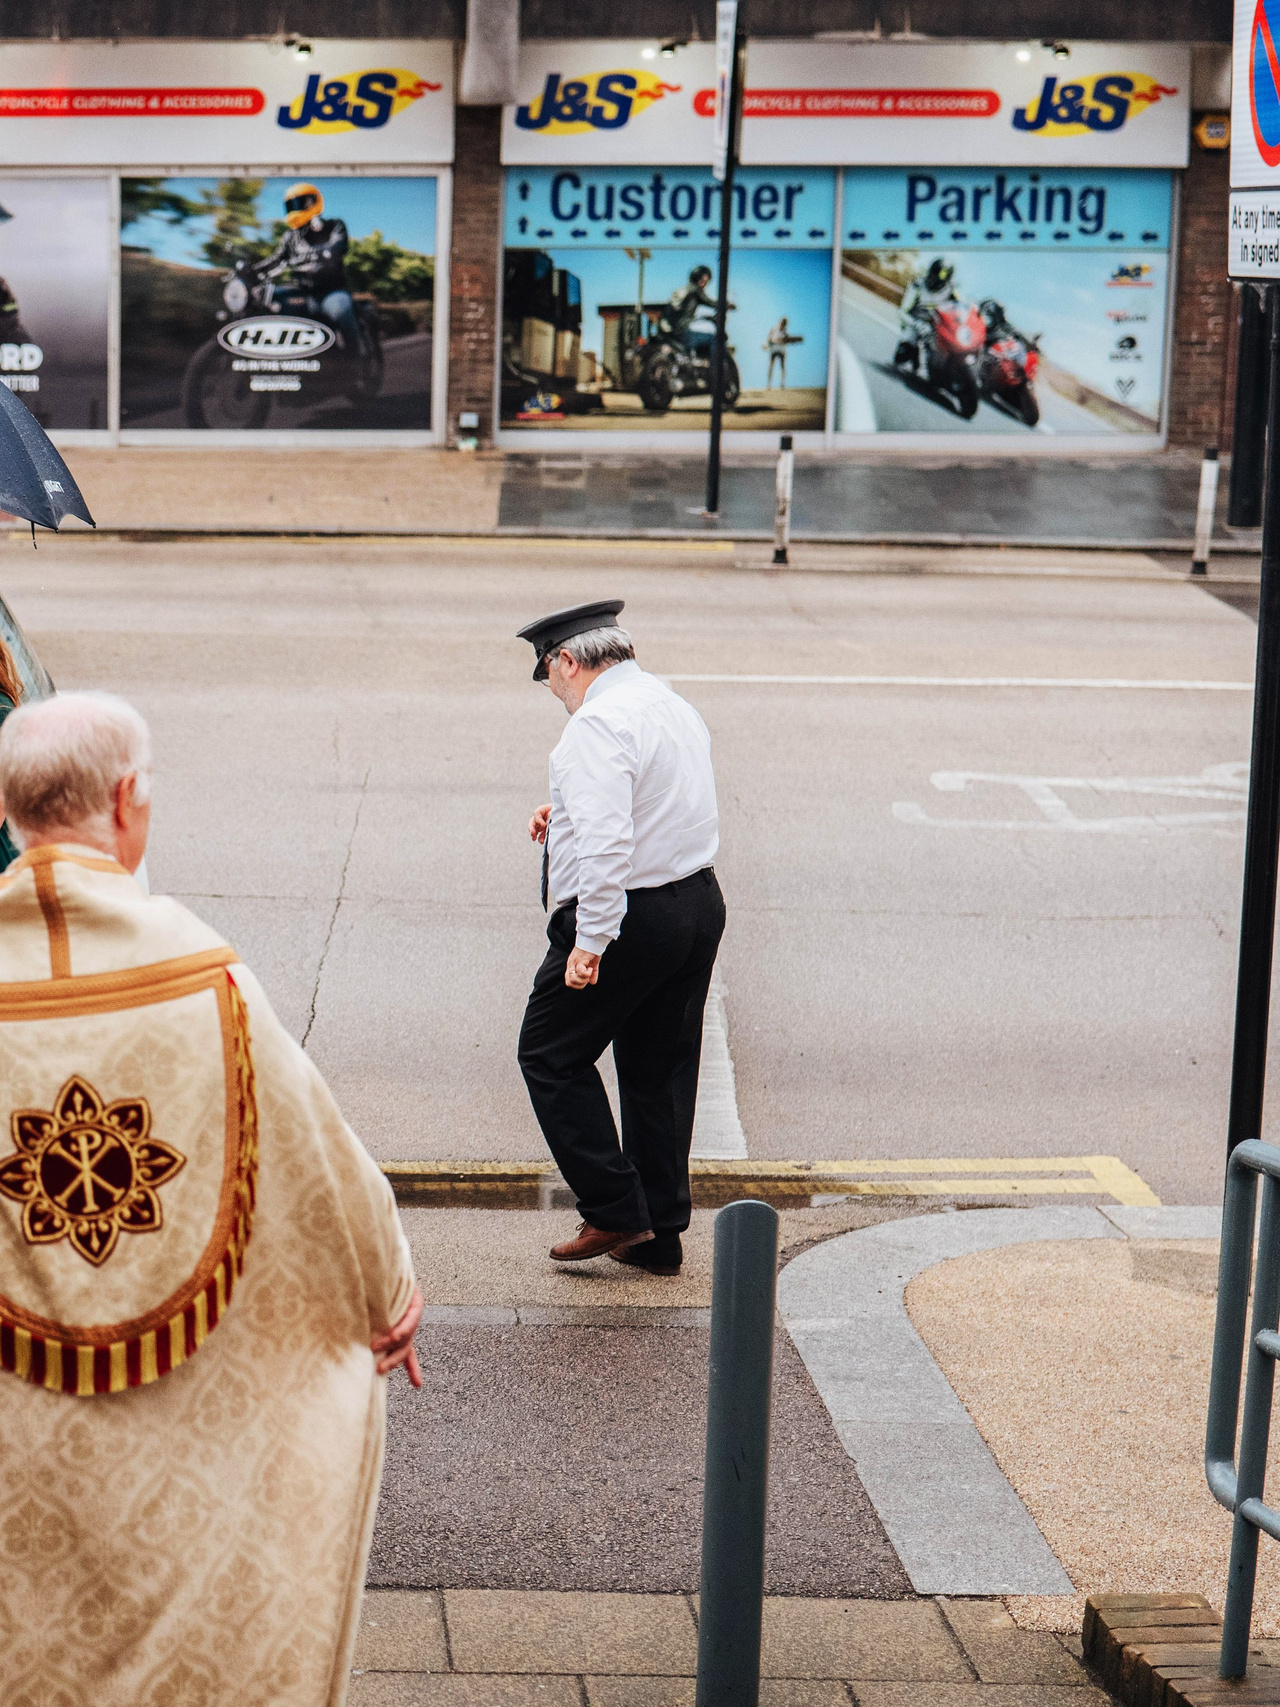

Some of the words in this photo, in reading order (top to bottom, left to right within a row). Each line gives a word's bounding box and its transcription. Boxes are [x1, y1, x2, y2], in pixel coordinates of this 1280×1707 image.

[72, 95, 147, 109] CLOTHING
[162, 95, 252, 109] ACCESSORIES
[277, 73, 397, 128] J&S
[515, 74, 637, 129] J&S
[804, 96, 880, 110] CLOTHING
[897, 96, 989, 110] ACCESSORIES
[1012, 76, 1134, 131] J&S
[549, 171, 804, 223] Customer
[905, 172, 1107, 236] Parking
[1232, 205, 1242, 229] At
[1244, 210, 1259, 233] any
[1262, 205, 1280, 229] time
[1240, 238, 1249, 262] in
[1251, 238, 1280, 267] signed
[238, 330, 316, 346] HJC
